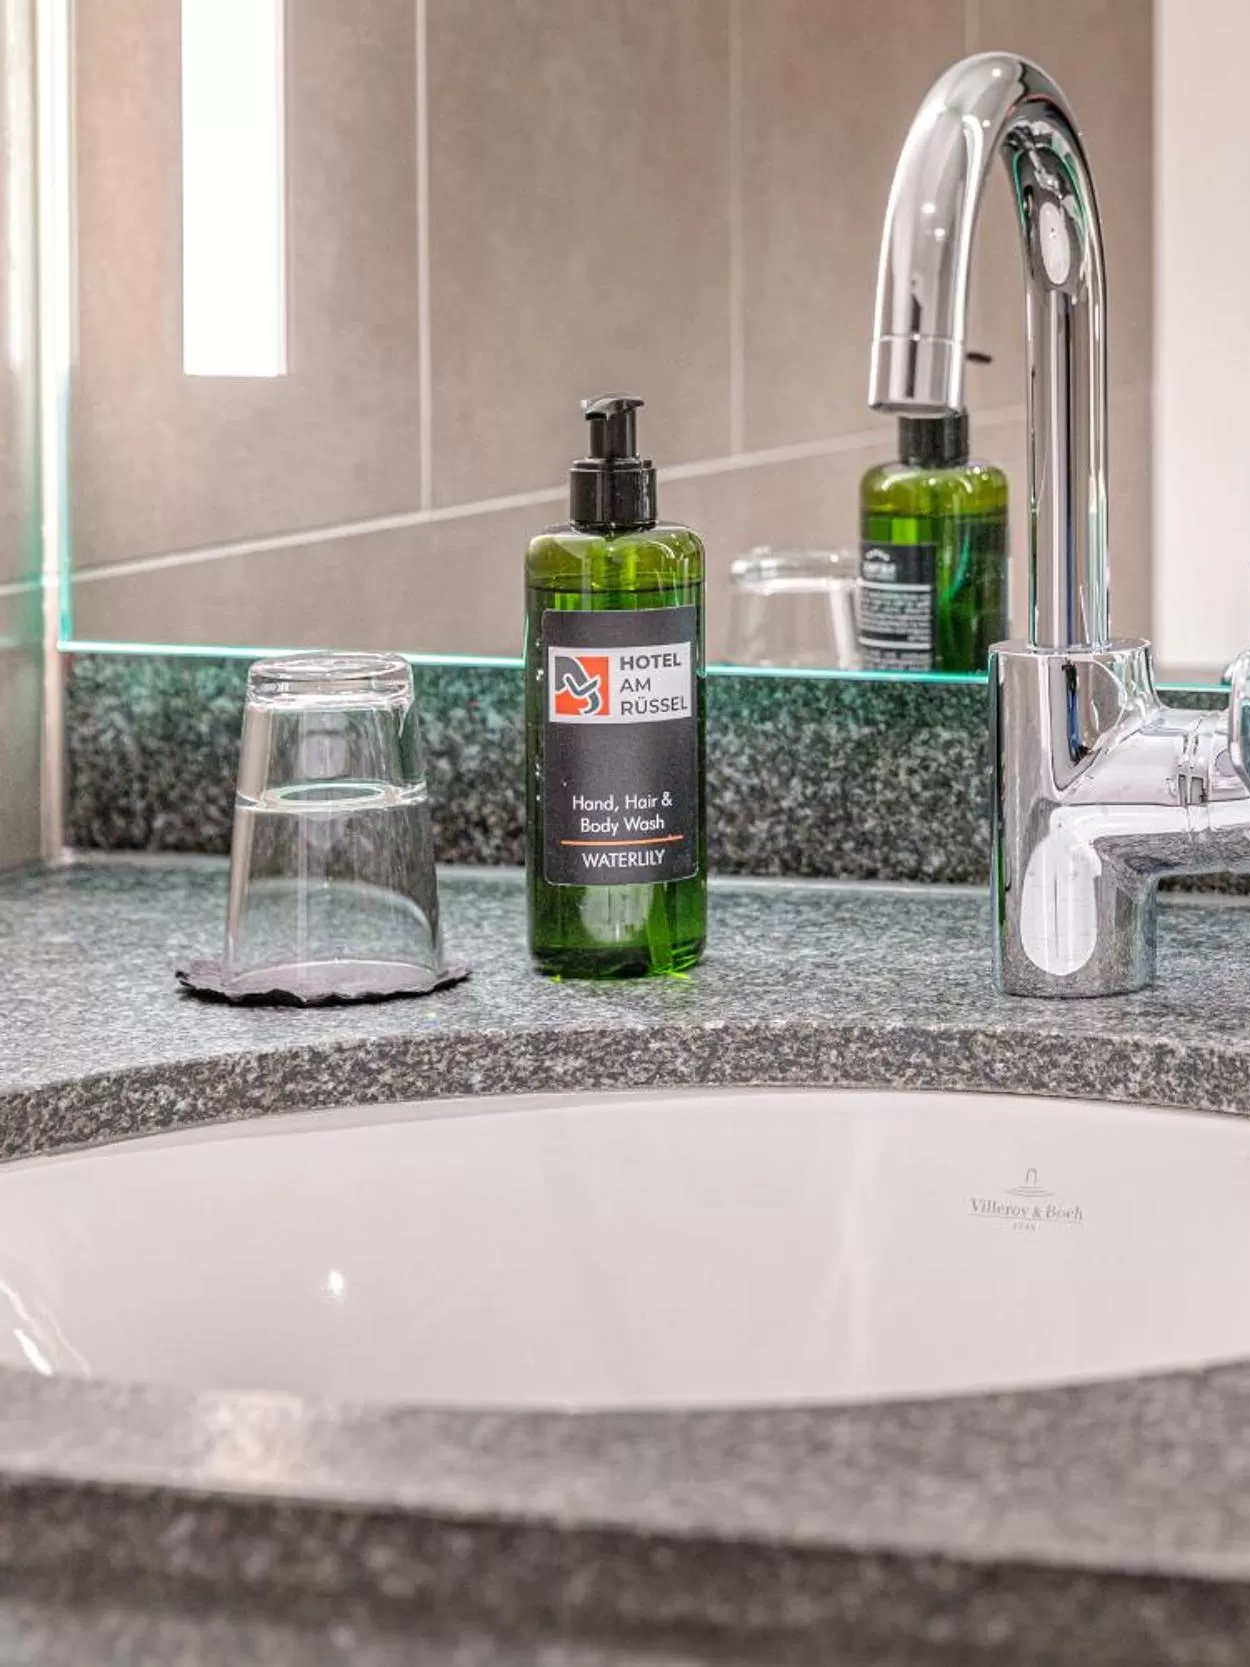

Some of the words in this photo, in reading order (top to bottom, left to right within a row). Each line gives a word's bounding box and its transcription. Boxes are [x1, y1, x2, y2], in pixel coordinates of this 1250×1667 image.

[620, 653, 681, 671] HOTEL
[620, 679, 651, 693] AM
[621, 696, 687, 716] RÜSSEL
[572, 796, 620, 811] Hand,
[625, 792, 656, 809] Hair
[661, 792, 672, 807] &
[580, 818, 619, 836] Body
[624, 815, 665, 831] Wash
[582, 850, 665, 868] WATERLILY
[970, 1198, 1029, 1218] Villeroy
[1032, 1207, 1041, 1218] &
[1046, 1204, 1083, 1221] Boch
